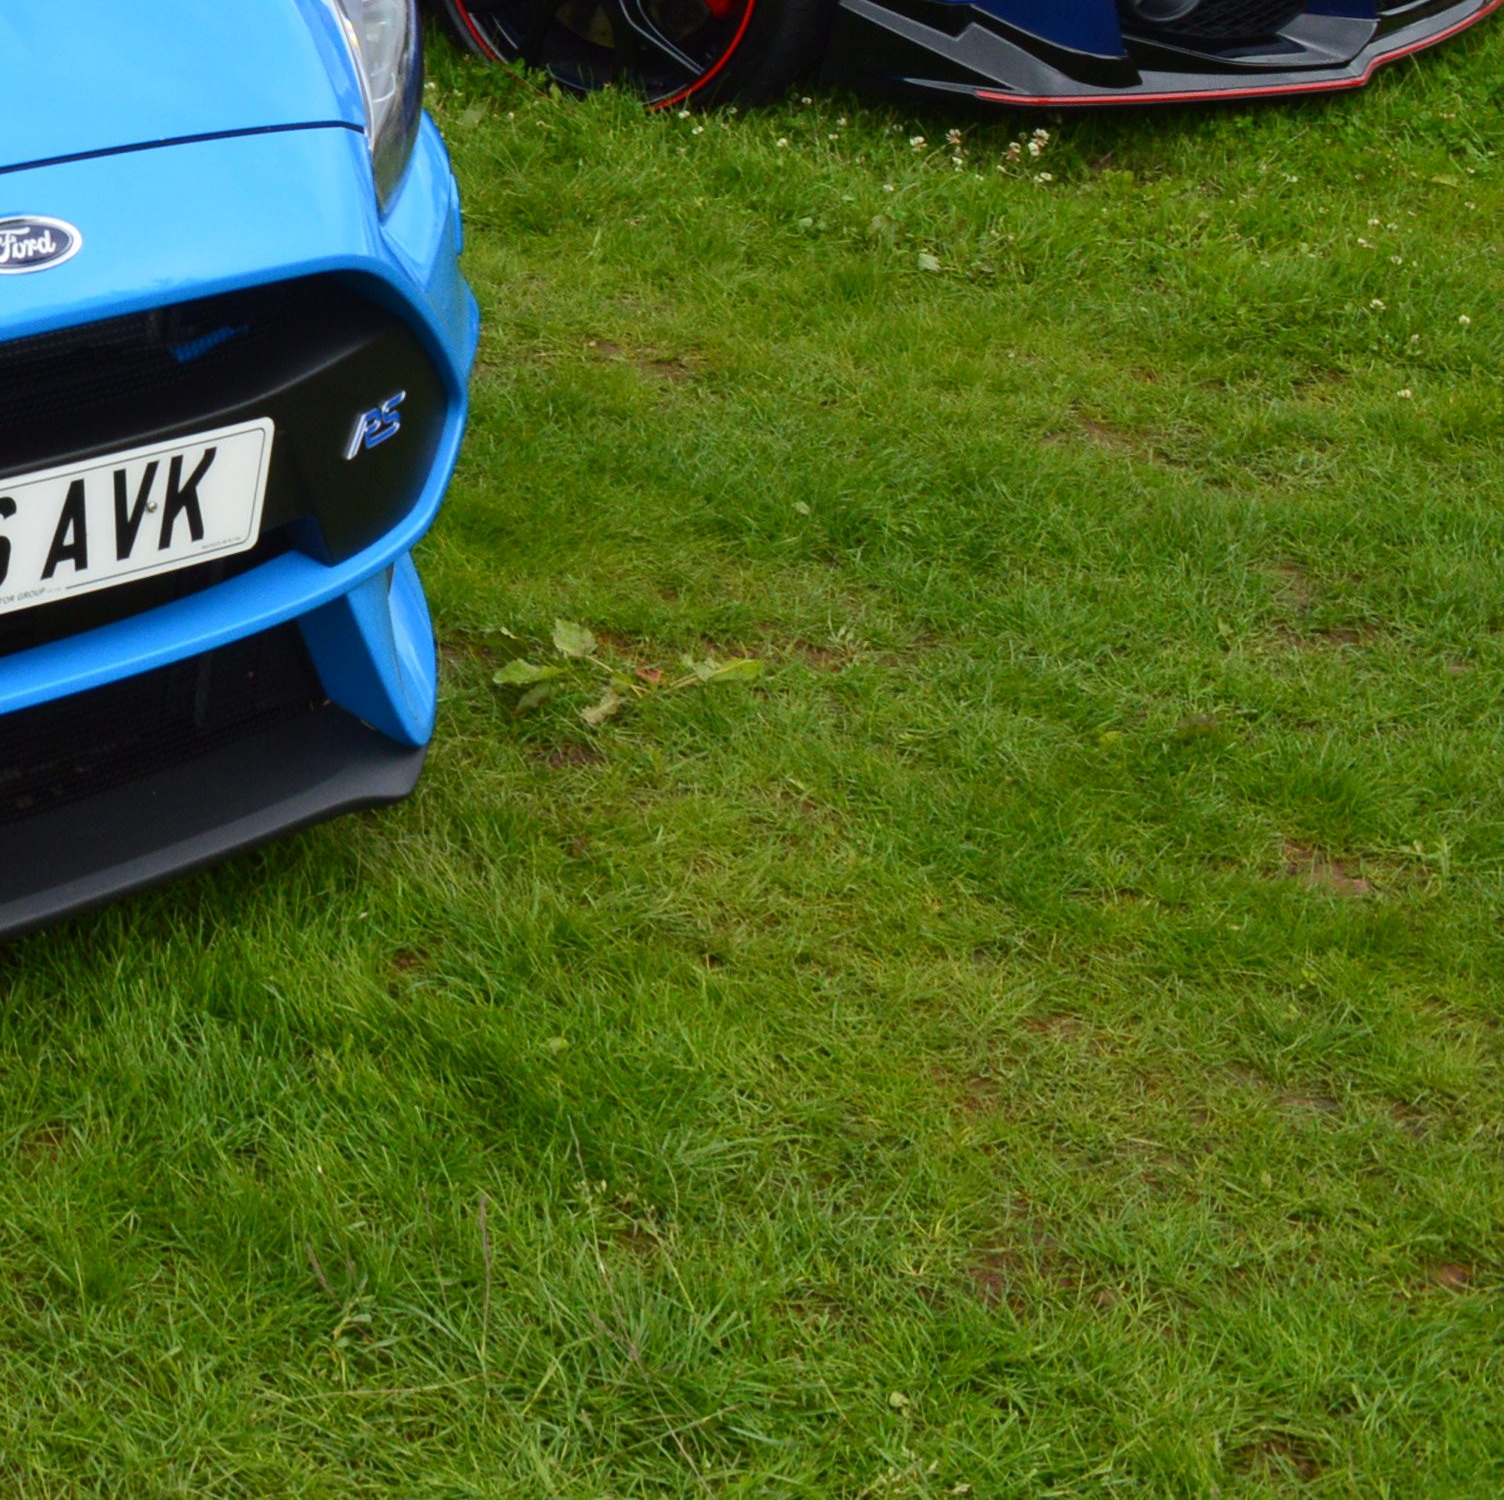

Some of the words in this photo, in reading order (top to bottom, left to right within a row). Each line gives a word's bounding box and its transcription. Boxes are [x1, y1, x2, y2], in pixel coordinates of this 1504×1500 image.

[346, 390, 406, 460] RS
[40, 447, 217, 581] AVK
[17, 587, 46, 601] GROUP
